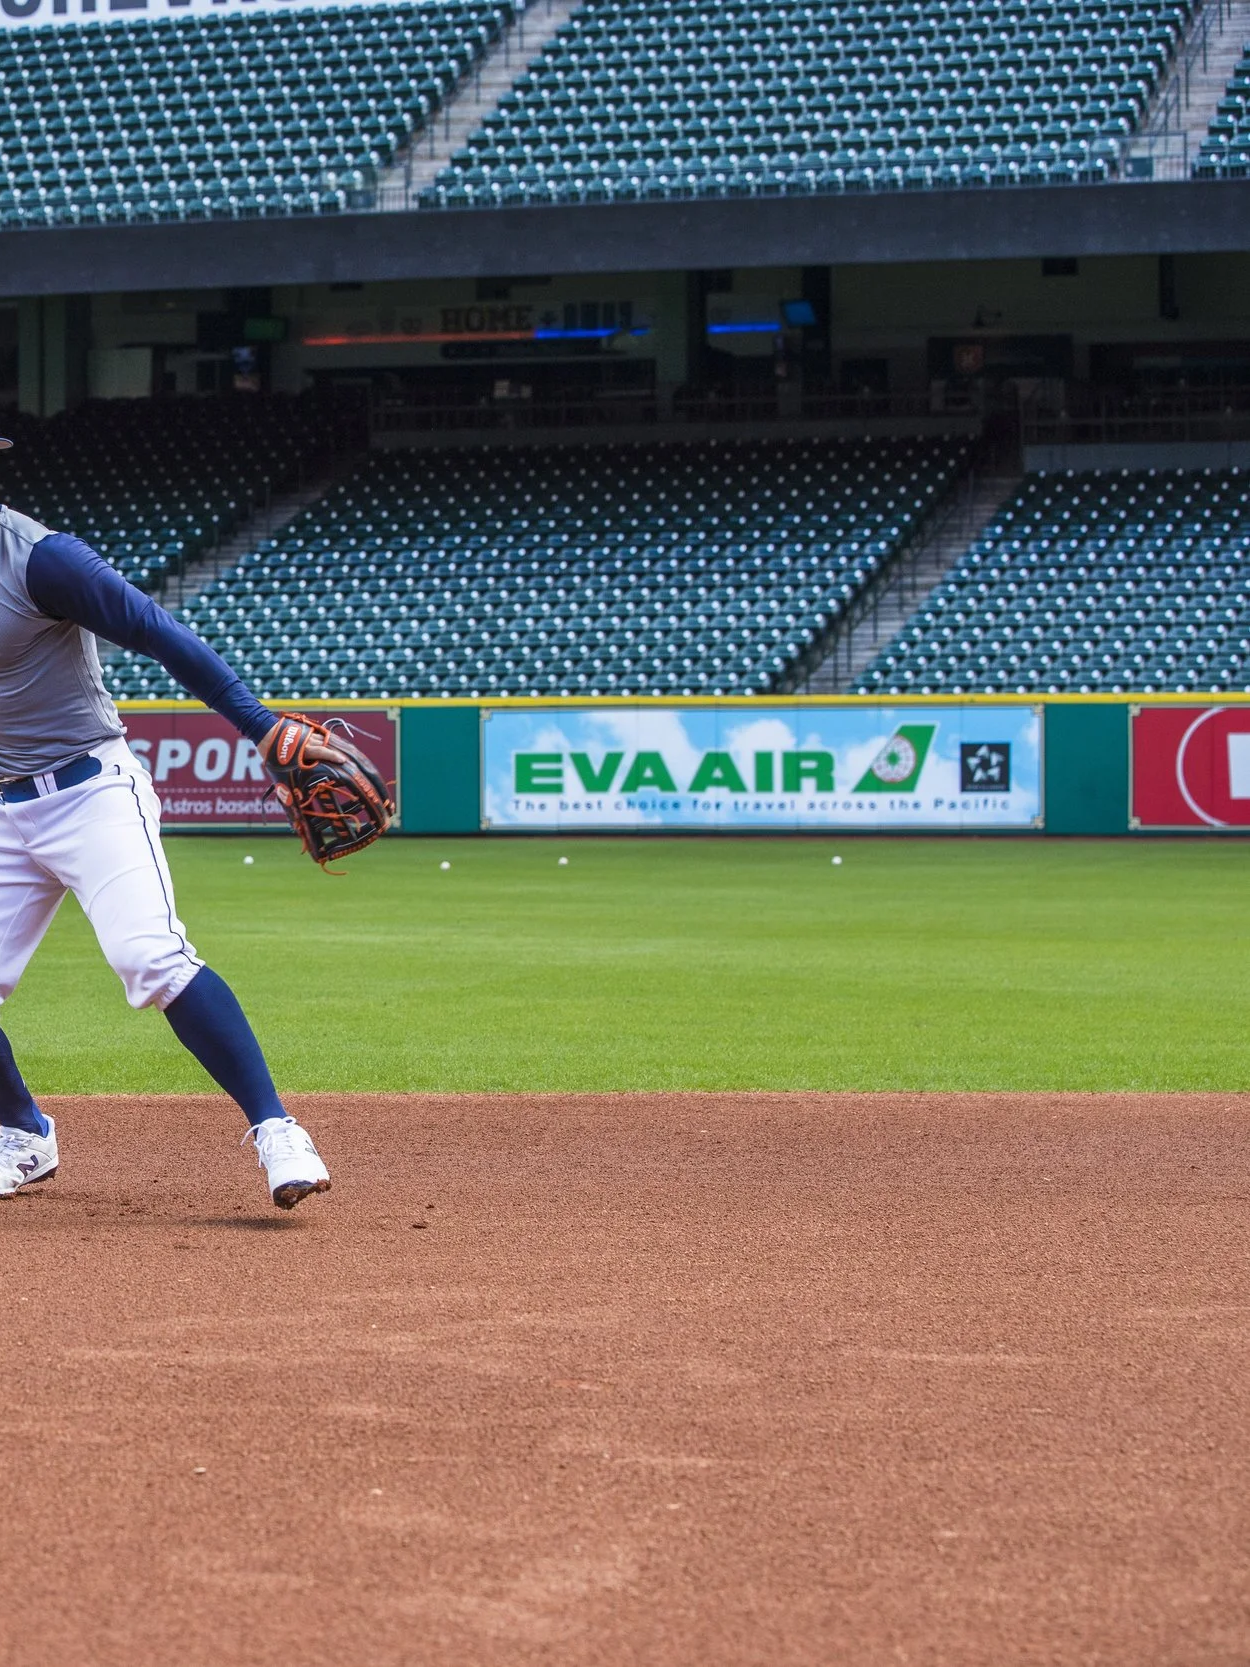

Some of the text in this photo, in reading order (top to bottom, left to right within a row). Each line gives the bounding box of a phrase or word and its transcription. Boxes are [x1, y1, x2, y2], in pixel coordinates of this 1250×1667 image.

[279, 725, 299, 760] Wilson
[161, 797, 210, 814] Astros
[513, 799, 1011, 812] The best choice for travel across the Pacific
